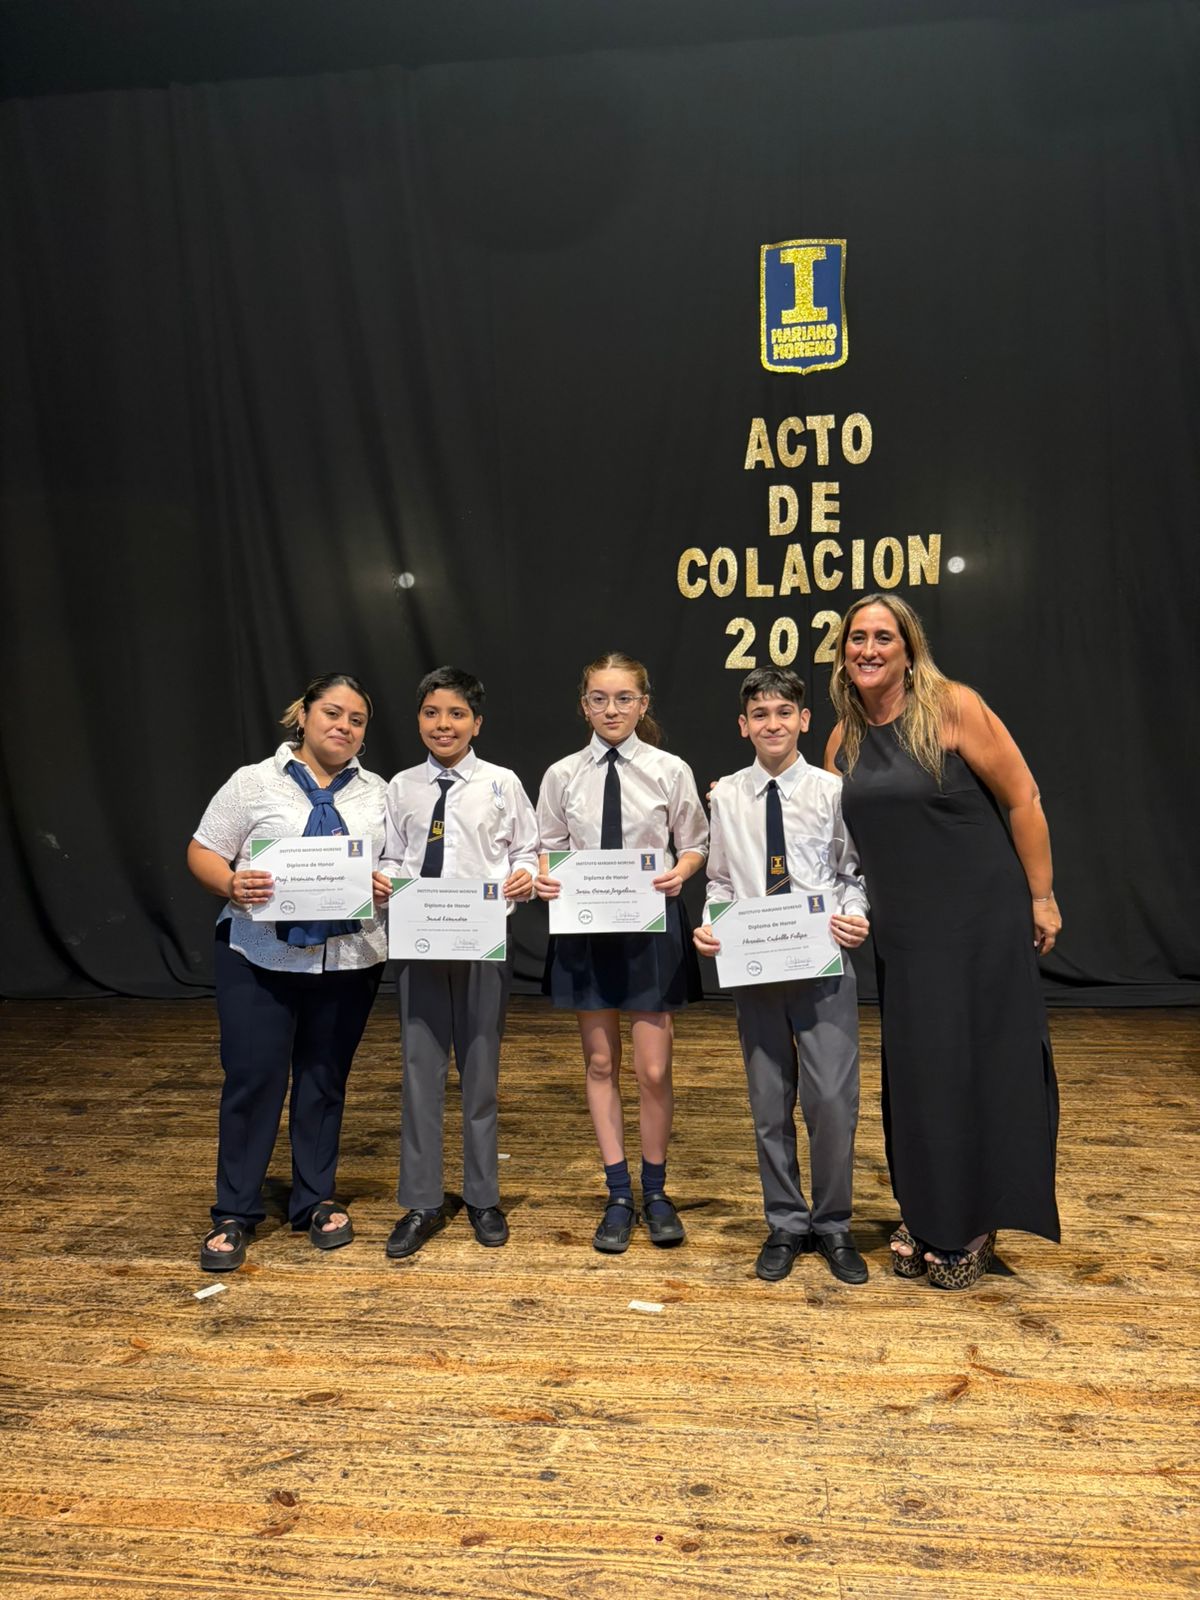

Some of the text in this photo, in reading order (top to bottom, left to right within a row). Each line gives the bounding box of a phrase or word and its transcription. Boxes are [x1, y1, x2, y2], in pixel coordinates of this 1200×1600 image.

[780, 246, 827, 325] I
[771, 323, 838, 344] MARIANO
[772, 340, 836, 360] MORENO
[743, 411, 873, 470] ACTO
[768, 481, 841, 536] DE
[676, 533, 942, 599] COLACION
[724, 610, 843, 670] 202
